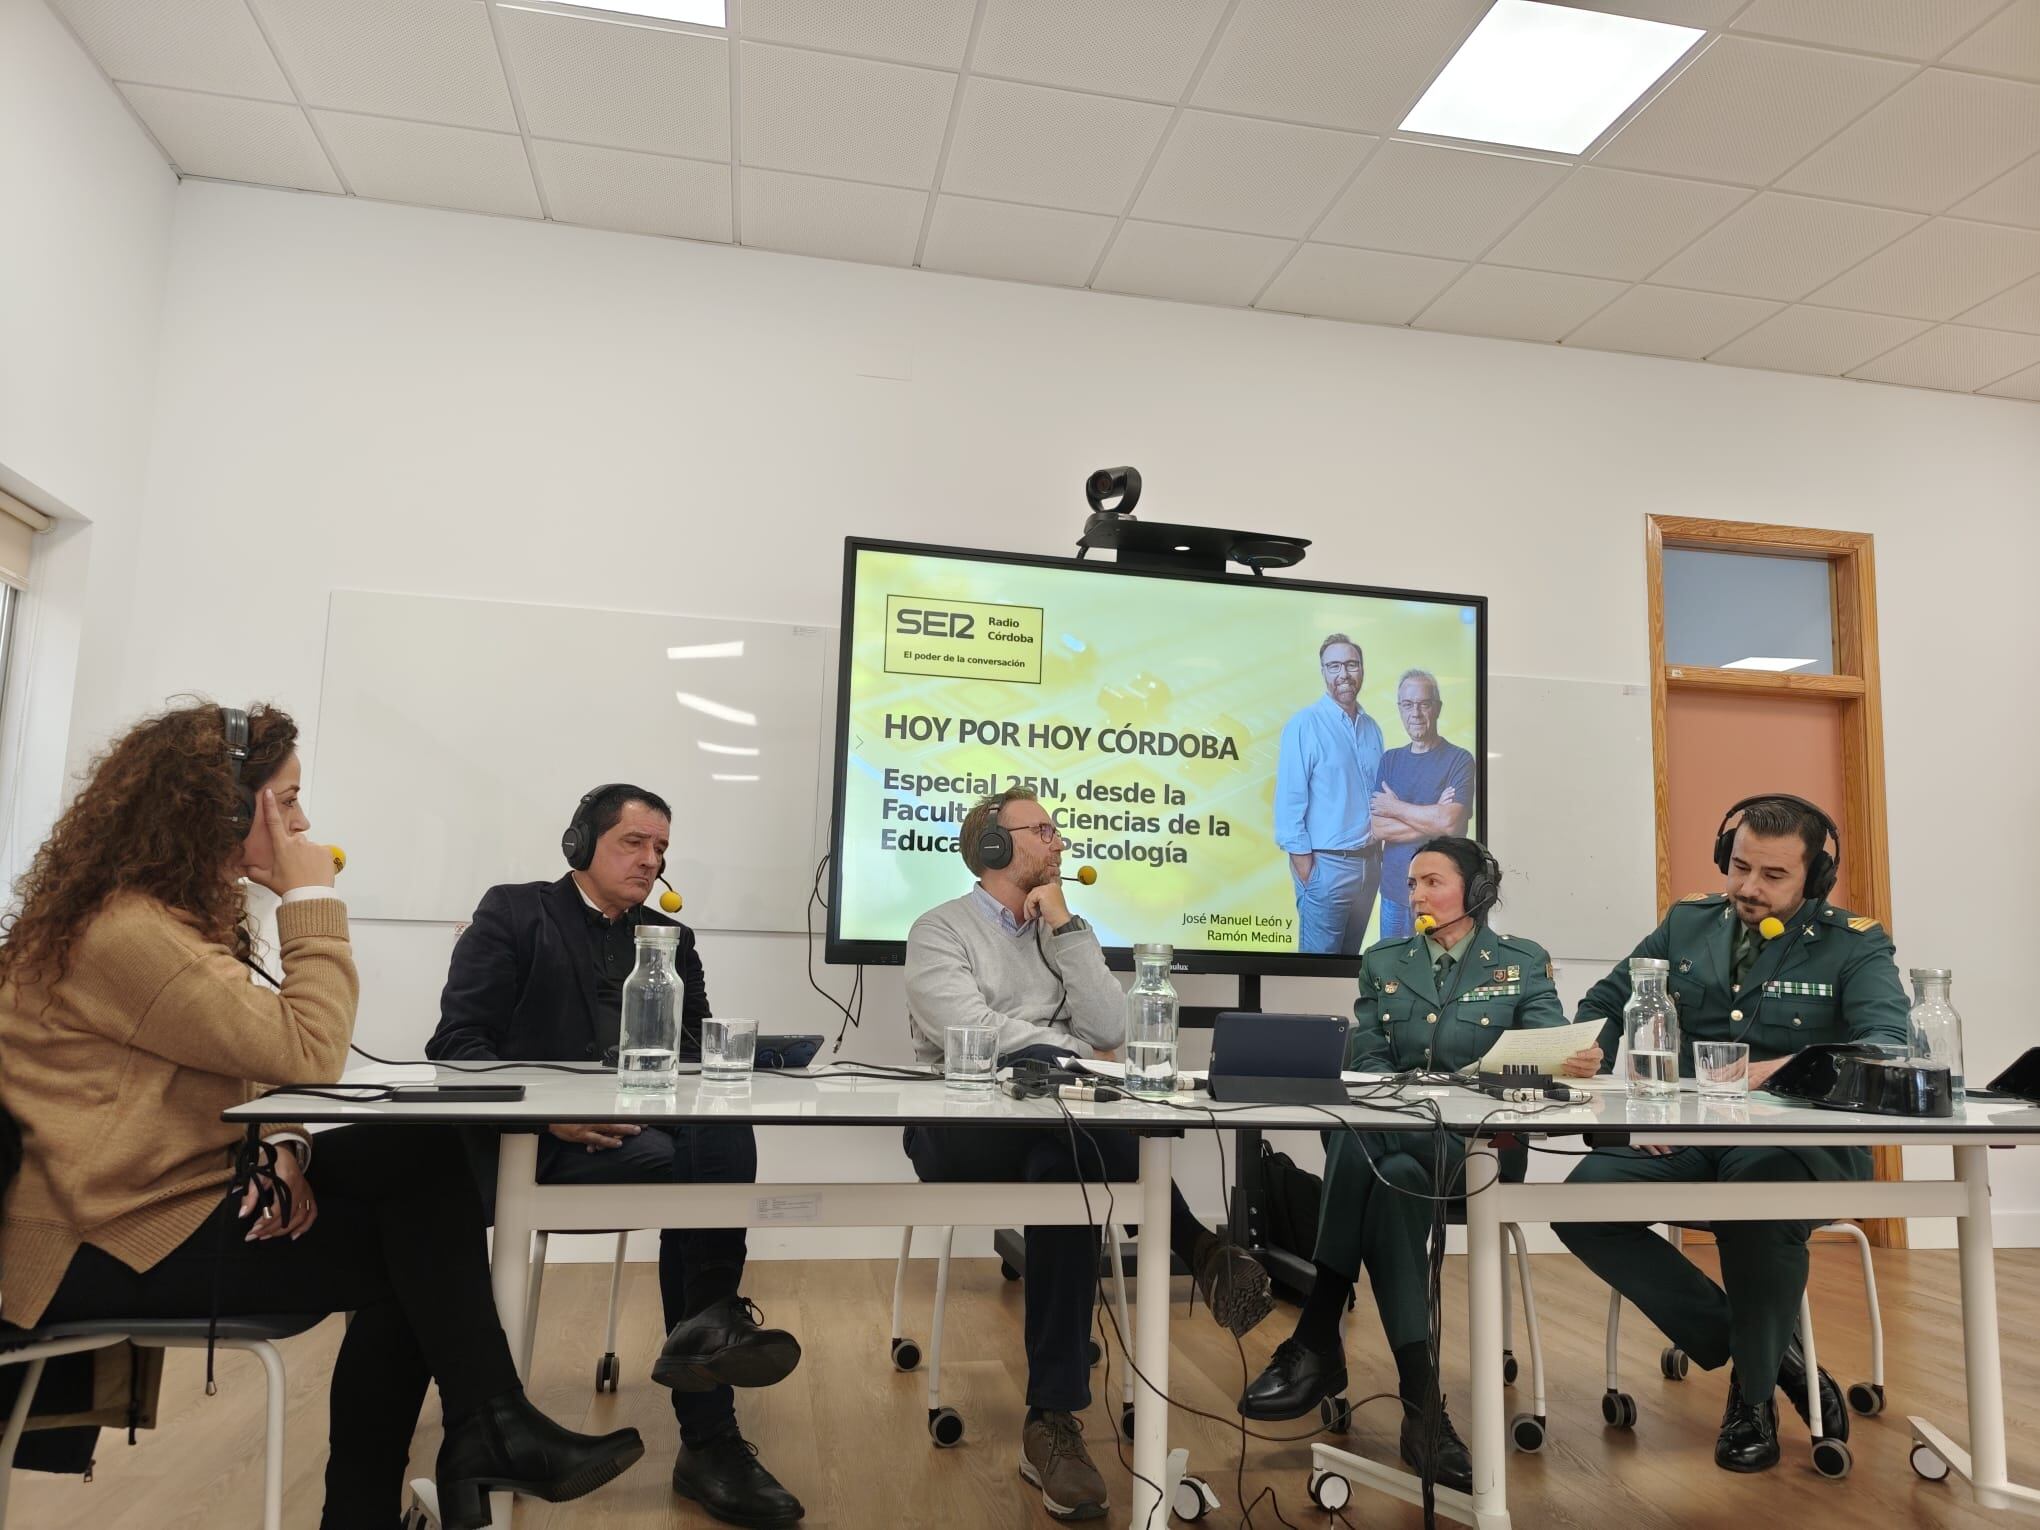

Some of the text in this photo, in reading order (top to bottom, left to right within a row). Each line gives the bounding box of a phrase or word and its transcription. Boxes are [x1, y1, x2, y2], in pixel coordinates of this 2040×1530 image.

[897, 609, 974, 639] SER
[988, 616, 1020, 629] Radio
[987, 631, 1034, 644] Córdoba
[903, 650, 1026, 668] El poder de la conversación
[885, 714, 1239, 760] HOY POR HOY CÓRDOBA
[883, 768, 997, 796] Especial
[1076, 780, 1155, 804] desde
[1164, 784, 1185, 805] la
[882, 799, 1229, 836] Facult Ciencias de la
[881, 828, 961, 853] Educa
[1182, 912, 1293, 930] José Manuel León y
[1207, 929, 1293, 944] Ramón Medina
